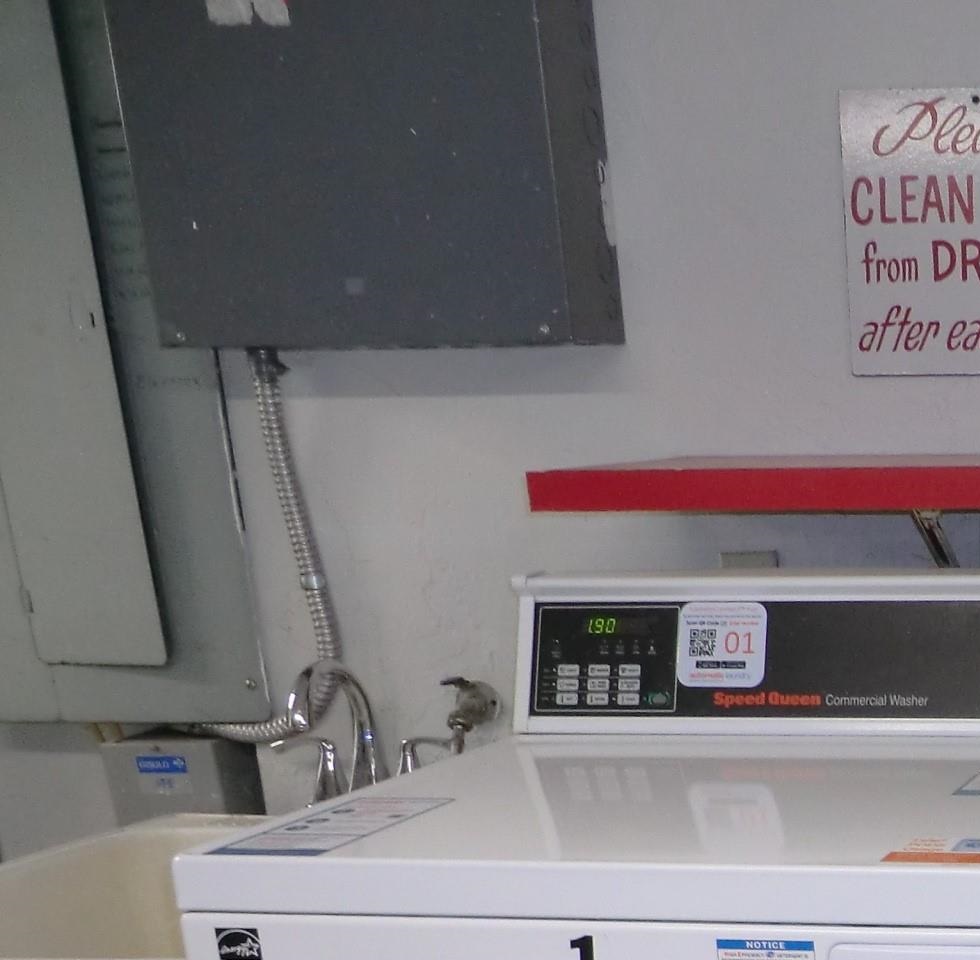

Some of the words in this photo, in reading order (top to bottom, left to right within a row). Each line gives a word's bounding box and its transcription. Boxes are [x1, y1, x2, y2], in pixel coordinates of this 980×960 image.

[850, 174, 974, 226] CLEAN
[861, 240, 919, 284] from
[858, 304, 940, 352] after
[724, 631, 756, 655] 01
[713, 692, 766, 708] Speed
[768, 691, 821, 706] Queen
[825, 693, 887, 706] Commercial
[890, 694, 929, 707] Washer
[745, 941, 785, 950] NOTICE
